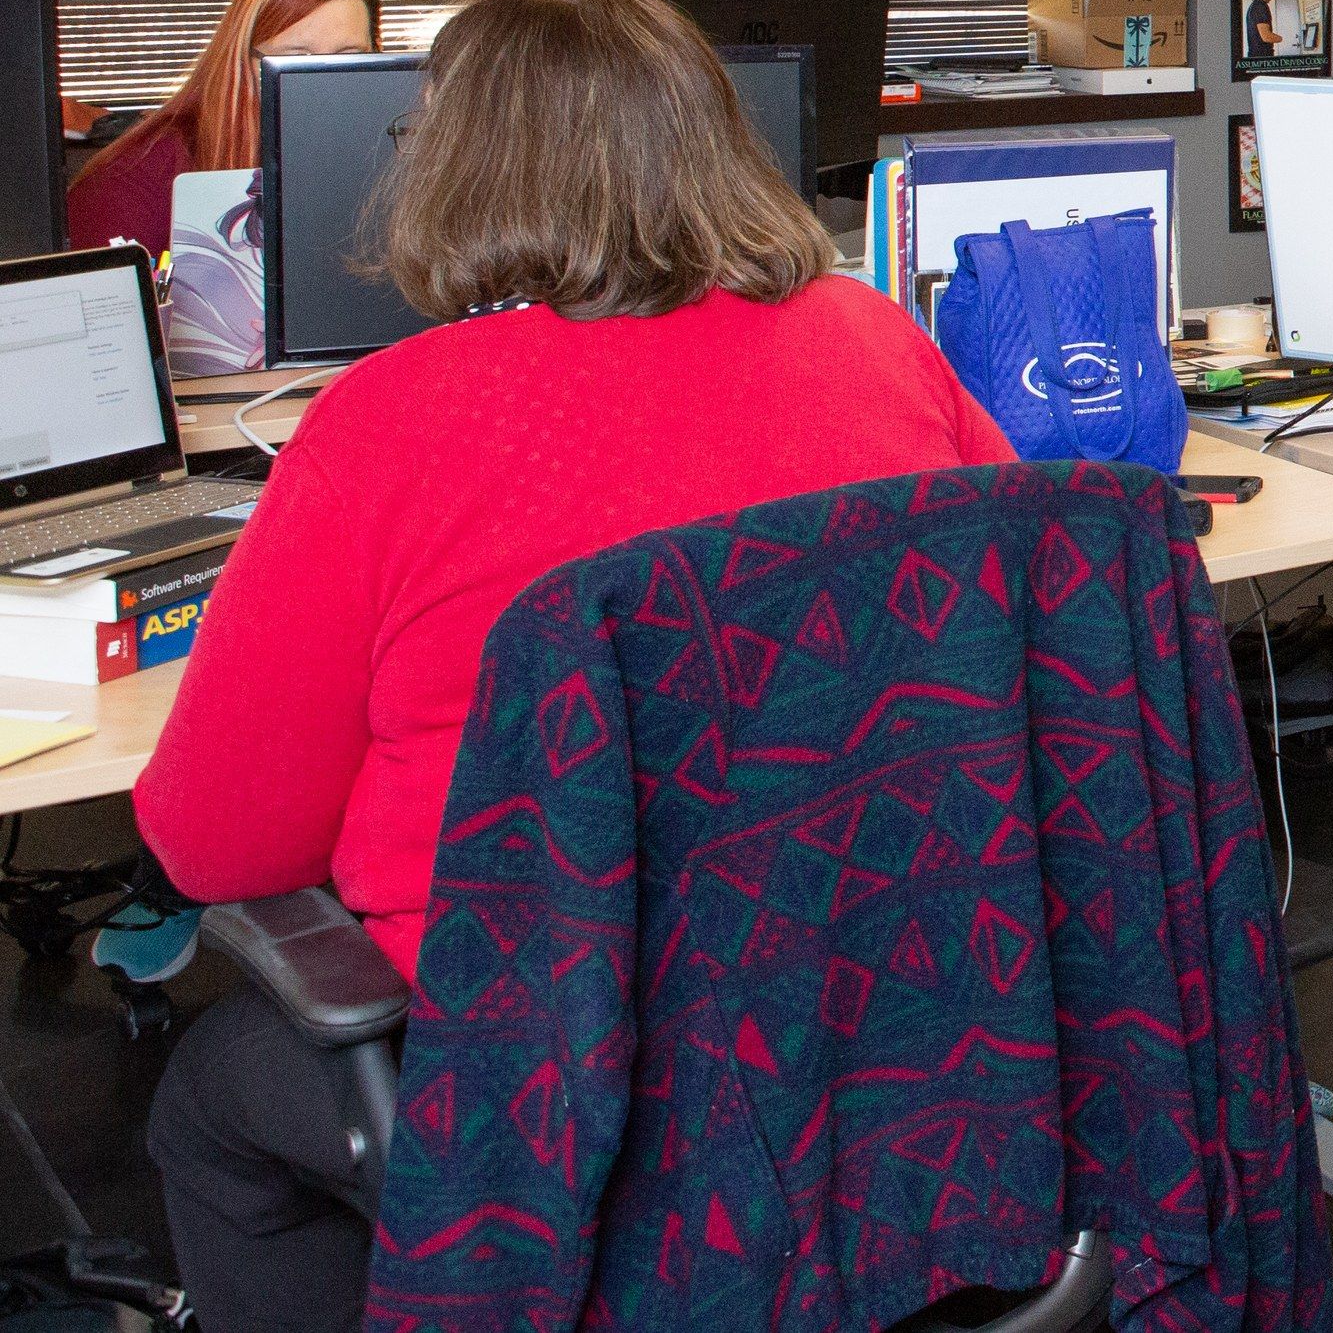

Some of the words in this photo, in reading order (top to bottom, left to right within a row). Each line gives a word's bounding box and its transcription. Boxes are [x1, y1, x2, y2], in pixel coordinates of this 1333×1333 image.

[1235, 59, 1280, 69] ASSUMPTION
[1280, 58, 1305, 67] DRIVEN
[141, 578, 182, 601] Software
